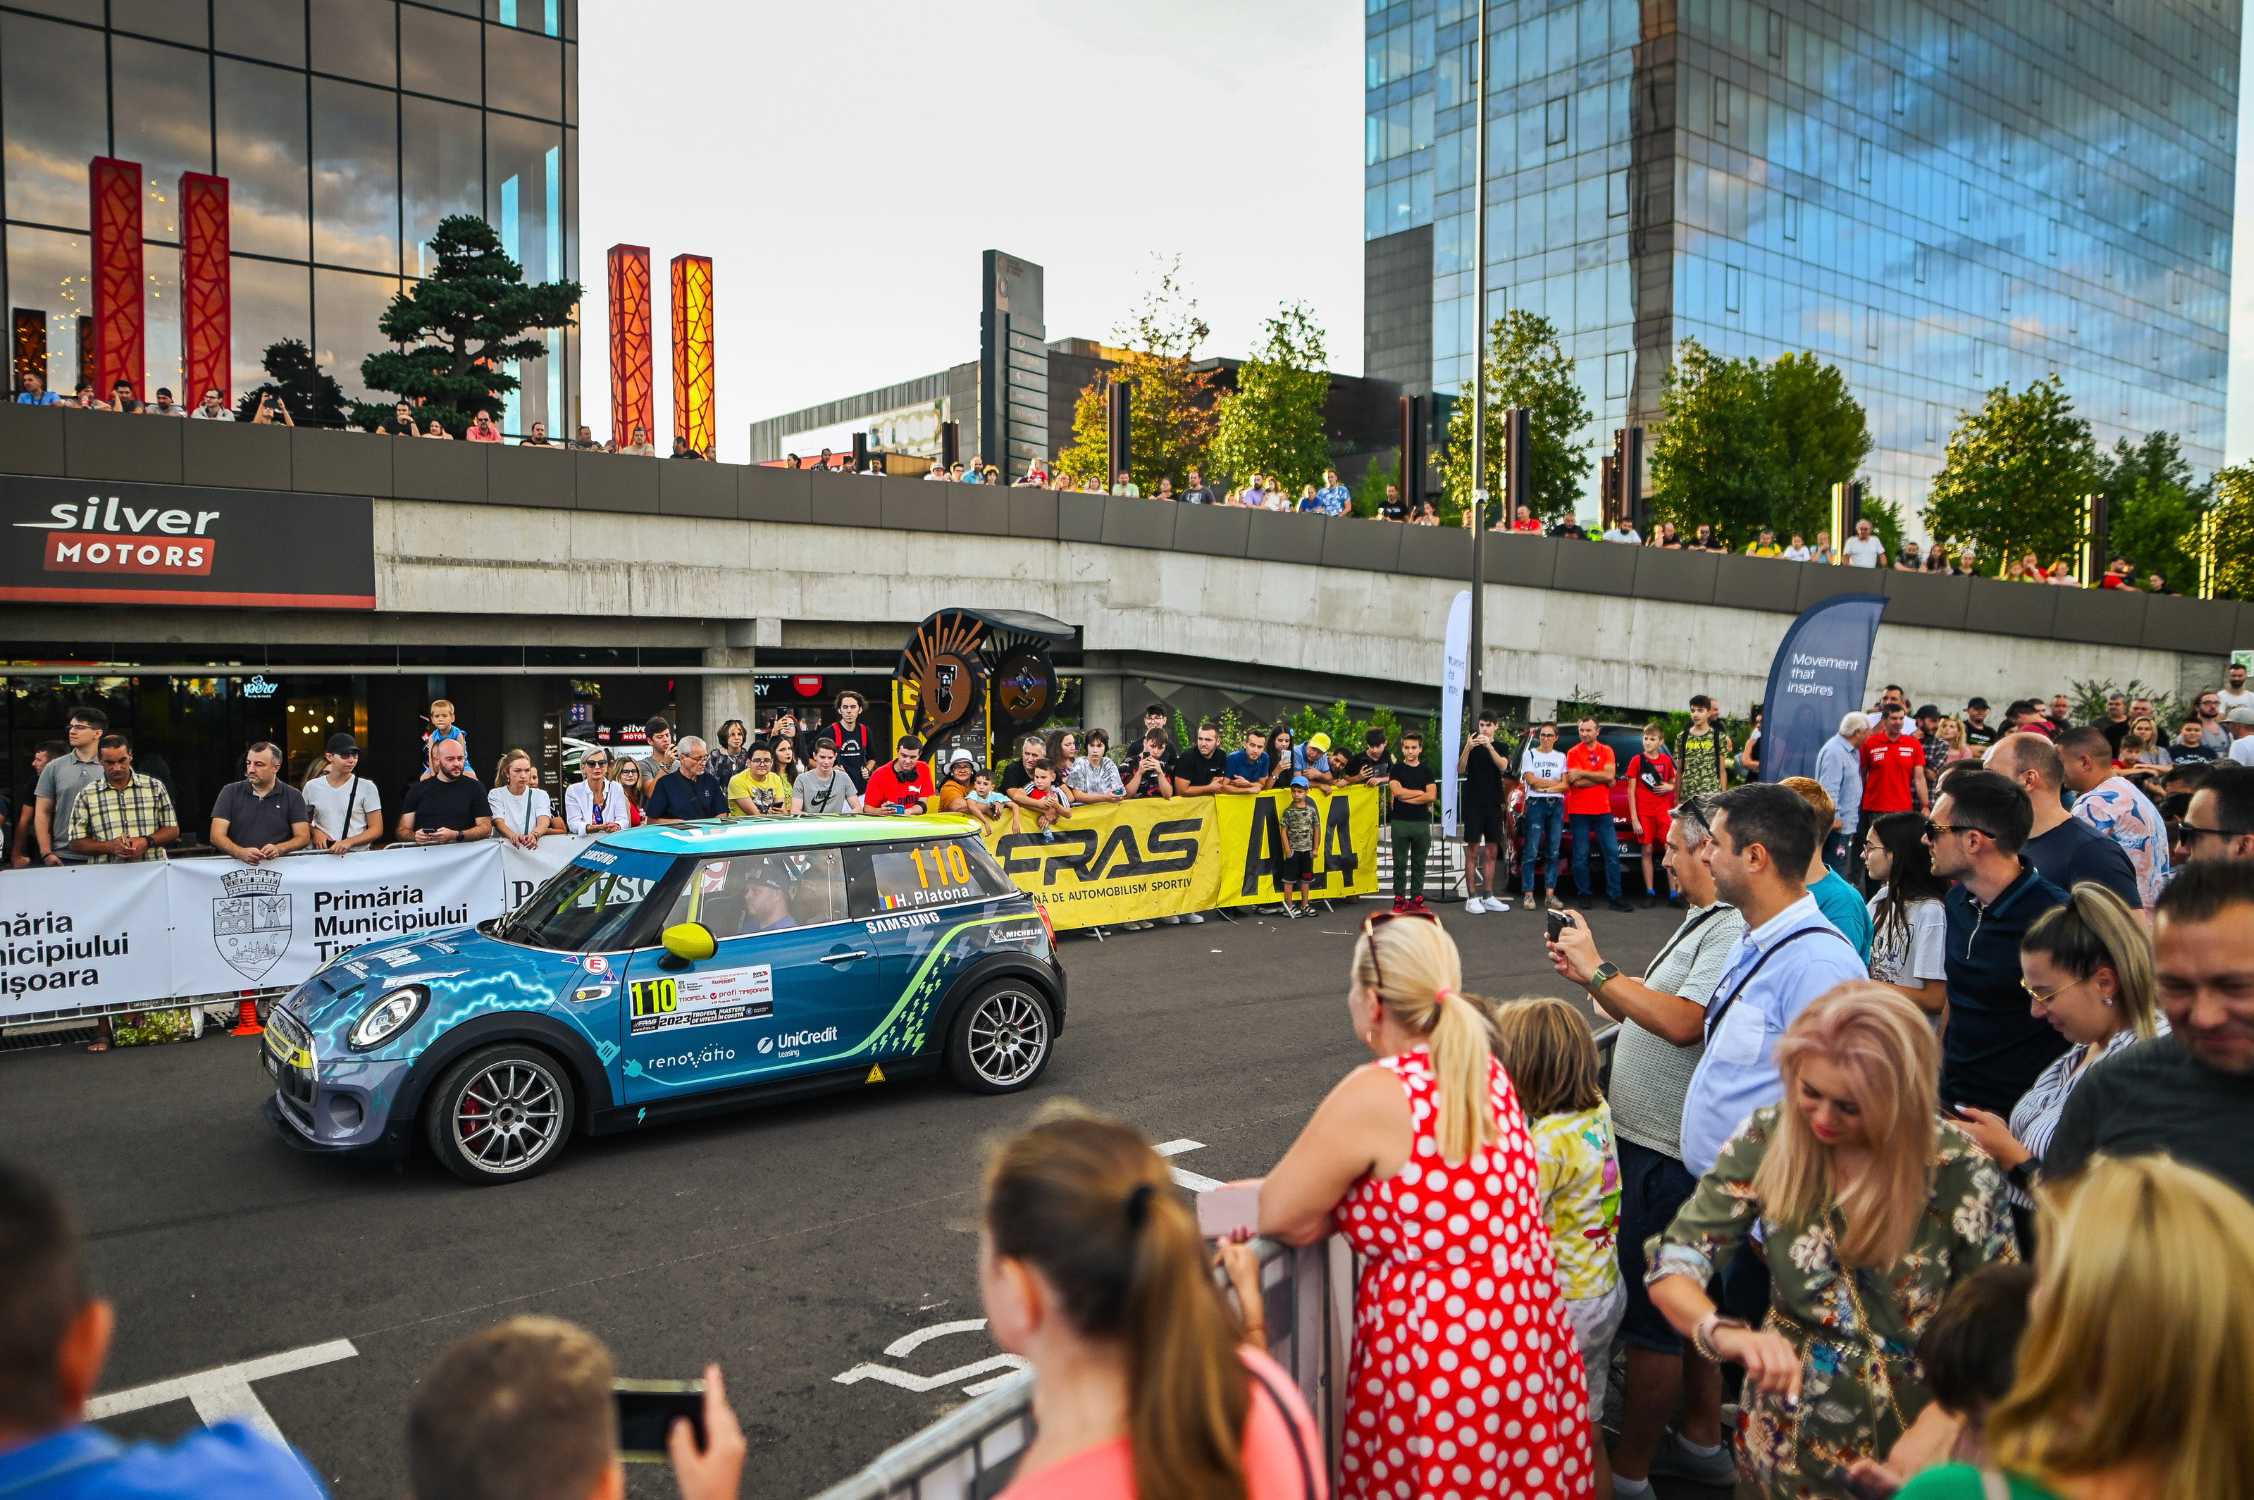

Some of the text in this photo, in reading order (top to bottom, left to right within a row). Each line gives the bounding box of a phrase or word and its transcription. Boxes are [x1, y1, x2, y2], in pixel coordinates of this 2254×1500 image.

[14, 496, 220, 535] silver
[56, 541, 204, 568] MOTORS
[1792, 652, 1859, 672] Movement
[1791, 668, 1816, 680] that
[1787, 681, 1834, 697] inspires
[910, 844, 971, 889] 110
[314, 885, 423, 913] Primăria
[896, 885, 970, 908] H. Platona
[1052, 892, 1065, 904] DE
[1068, 883, 1147, 901] AUTOMOBILISM
[1151, 877, 1193, 892] SPORTIV
[314, 903, 468, 938] Municipiului
[866, 911, 941, 934] SAMSUNG
[1005, 928, 1043, 938] MICHELIN
[589, 959, 602, 970] E
[0, 967, 99, 1001] ișoara
[718, 987, 737, 999] profi
[631, 978, 677, 1016] 110
[659, 1015, 690, 1028] 2023
[777, 1026, 838, 1049] UniCredit
